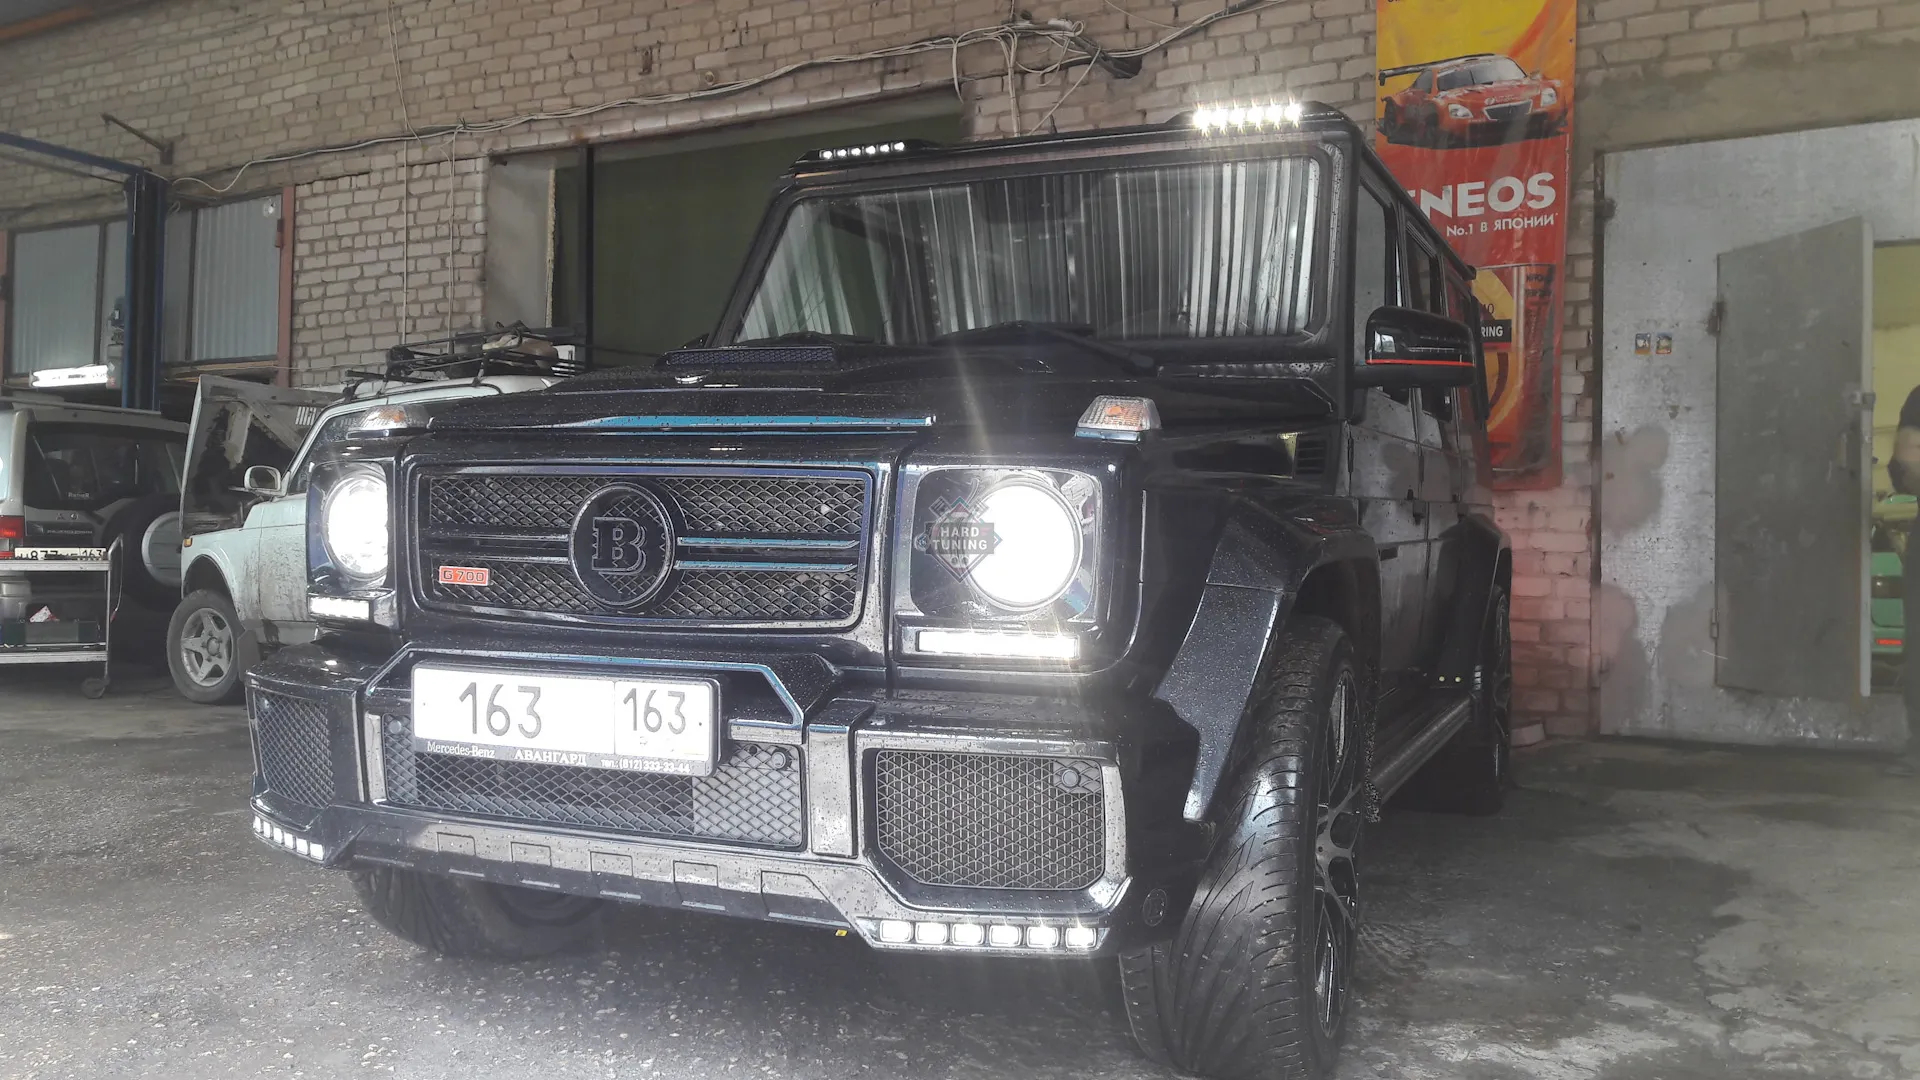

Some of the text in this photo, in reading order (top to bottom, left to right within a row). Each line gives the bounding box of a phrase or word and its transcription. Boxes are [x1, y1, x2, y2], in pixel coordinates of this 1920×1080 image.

[1407, 172, 1556, 219] NEOS
[1446, 224, 1473, 237] No.1
[1493, 215, 1555, 231] ЯПОНИИ
[592, 516, 648, 575] B
[458, 681, 687, 739] 163 163
[427, 740, 496, 759] Mercedes-Benz
[514, 748, 588, 767] АВАНГАРД
